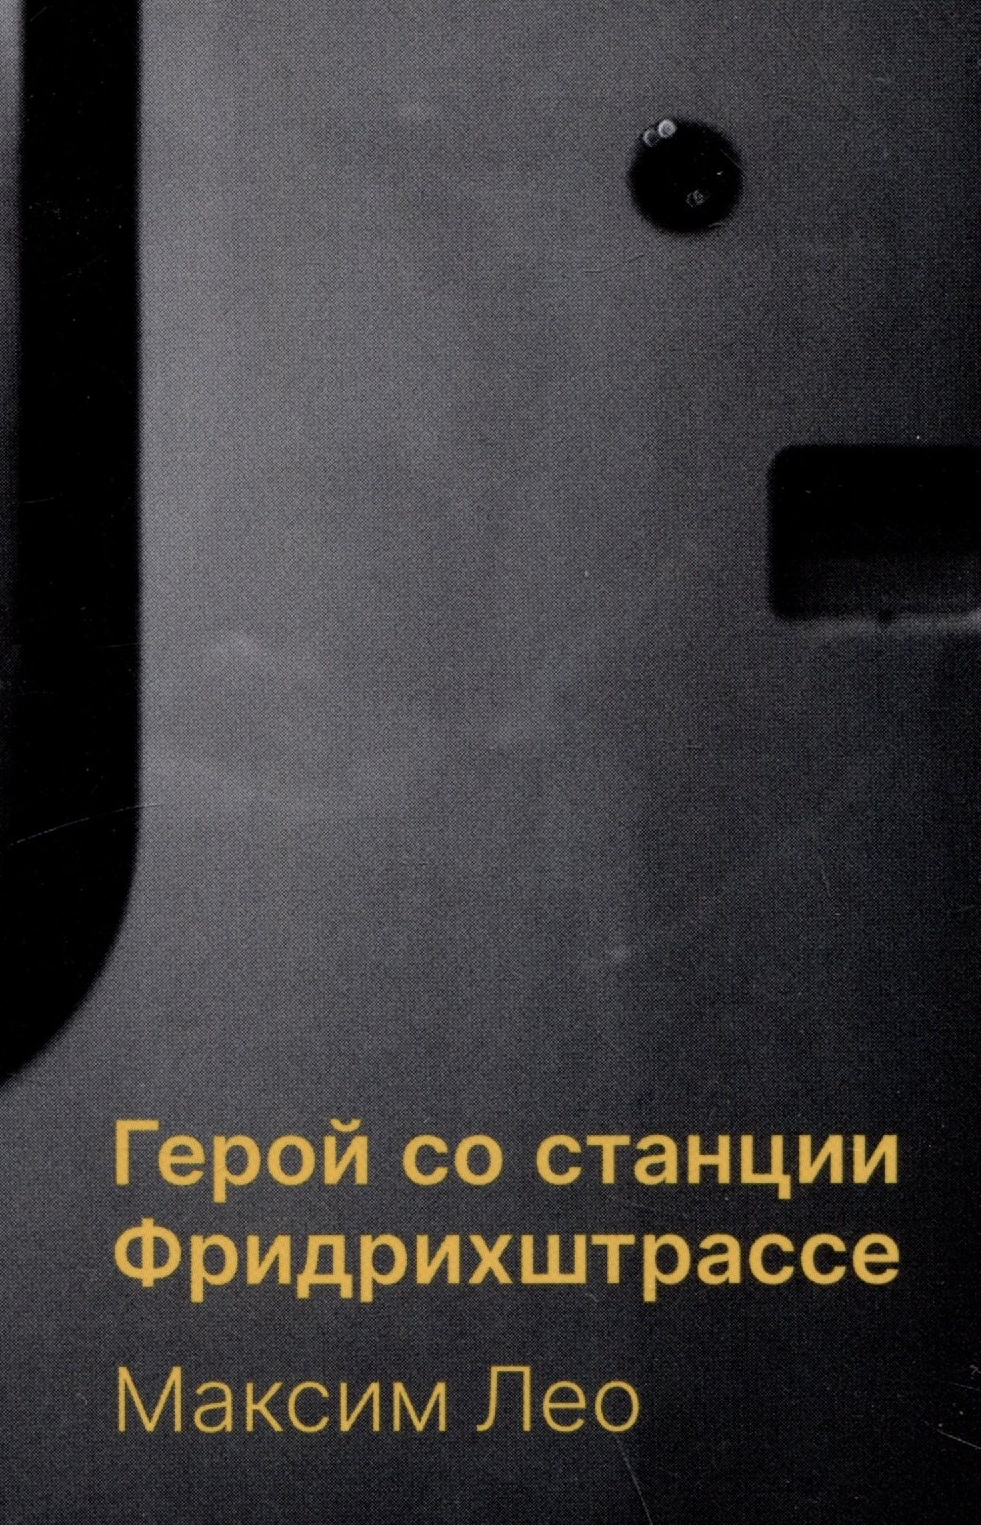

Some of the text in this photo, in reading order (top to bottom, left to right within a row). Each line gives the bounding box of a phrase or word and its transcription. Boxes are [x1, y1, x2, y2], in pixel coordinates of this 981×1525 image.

[114, 1117, 900, 1204] Герой со станции
[113, 1216, 902, 1304] Фридрихштрассе
[116, 1364, 642, 1434] Максим Лео
